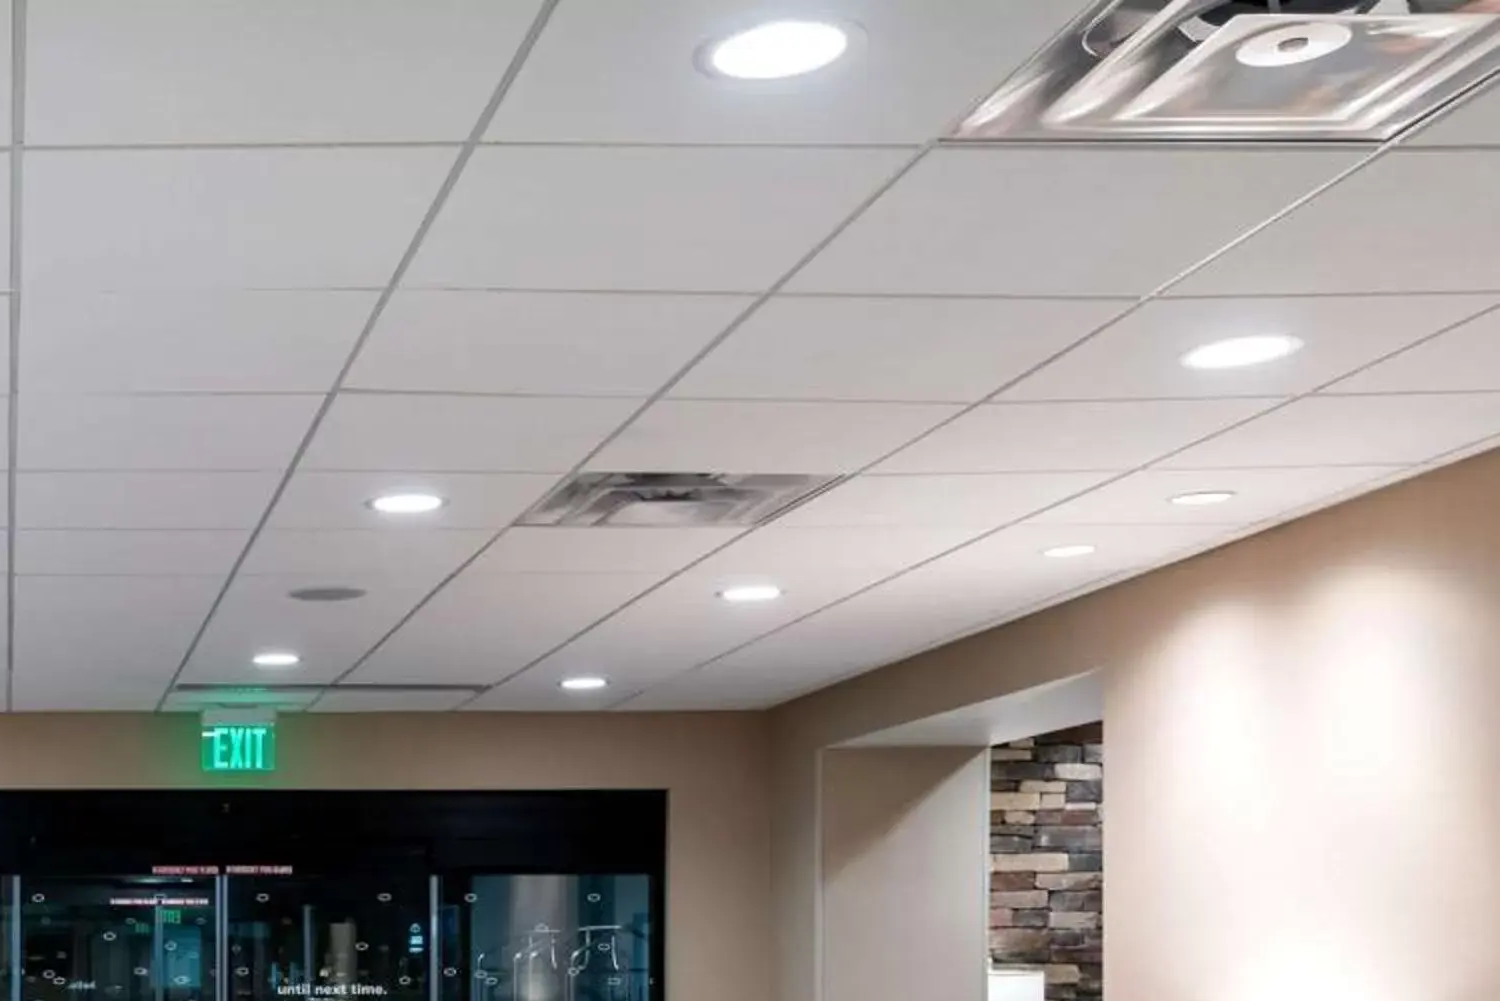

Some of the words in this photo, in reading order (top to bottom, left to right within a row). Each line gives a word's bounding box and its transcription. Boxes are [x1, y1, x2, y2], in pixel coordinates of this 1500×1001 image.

[214, 727, 267, 768] EXIT
[277, 983, 310, 995] until
[315, 984, 347, 995] next
[351, 983, 388, 995] time.
